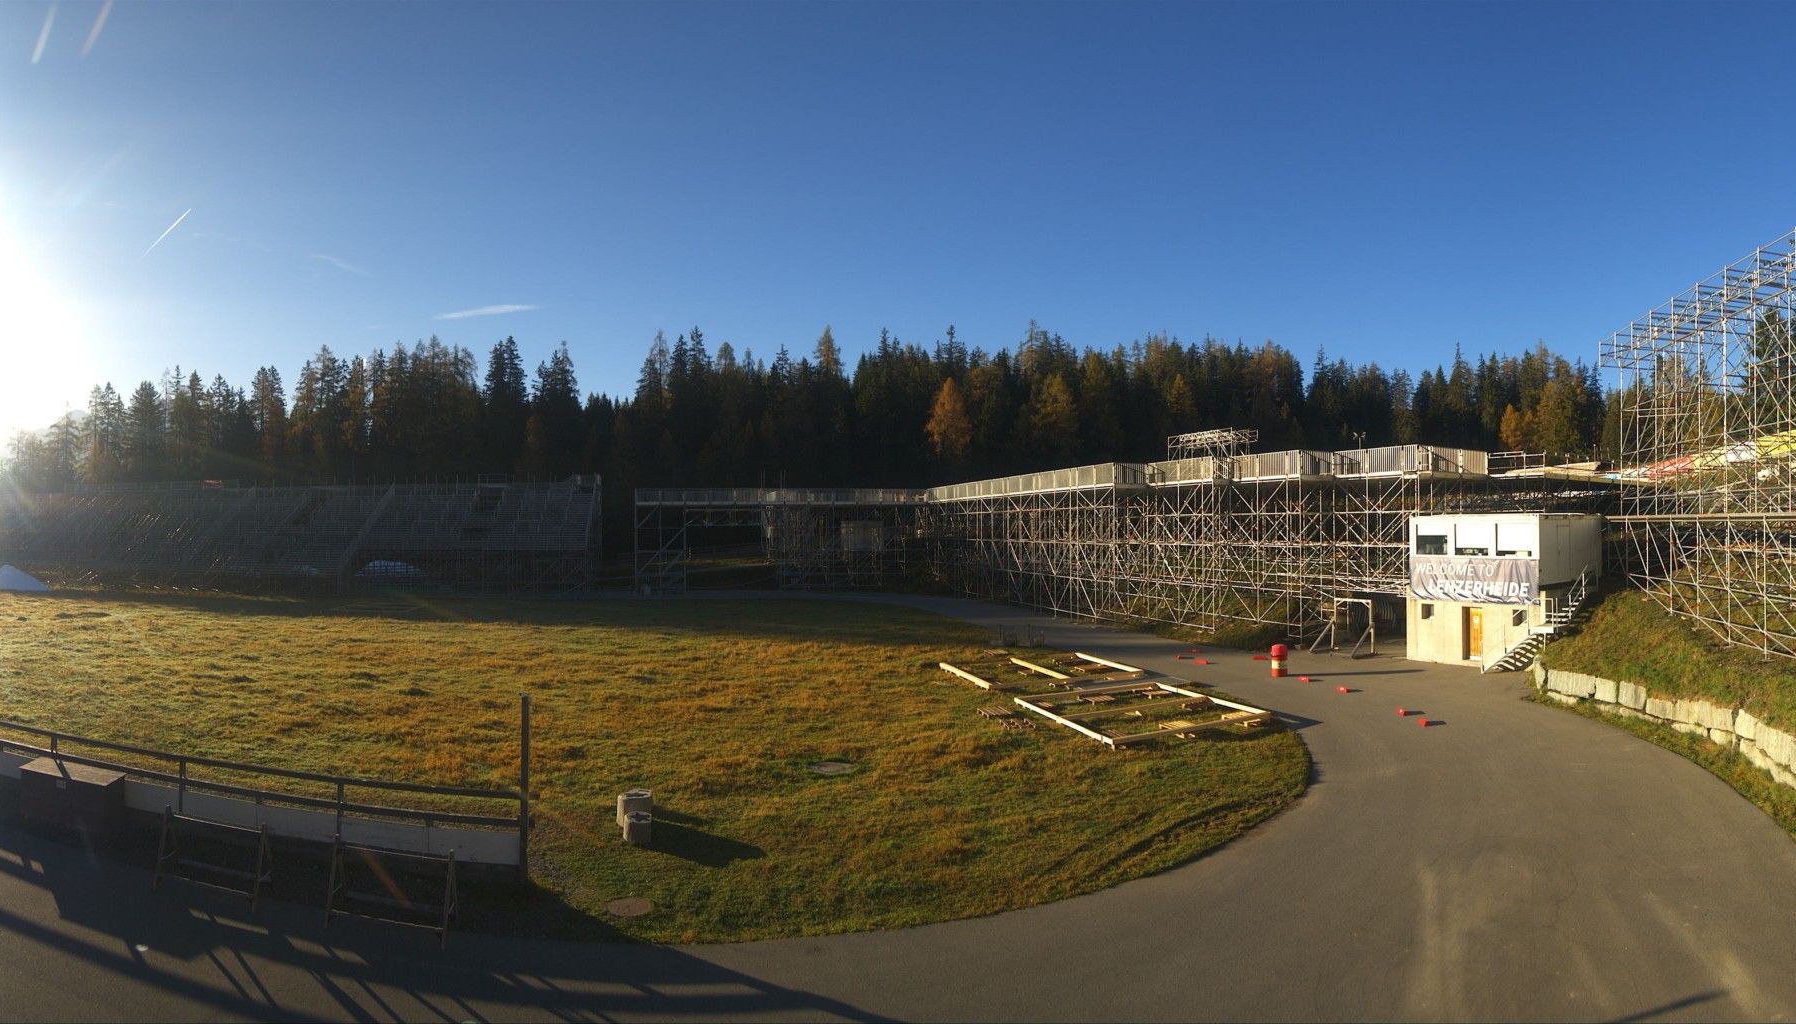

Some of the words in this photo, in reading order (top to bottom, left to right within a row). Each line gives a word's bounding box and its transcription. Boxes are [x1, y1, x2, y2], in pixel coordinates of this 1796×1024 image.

[1415, 561, 1475, 576] WELCOME
[1478, 563, 1495, 577] TO
[1428, 579, 1530, 598] LENZERHEIDE
